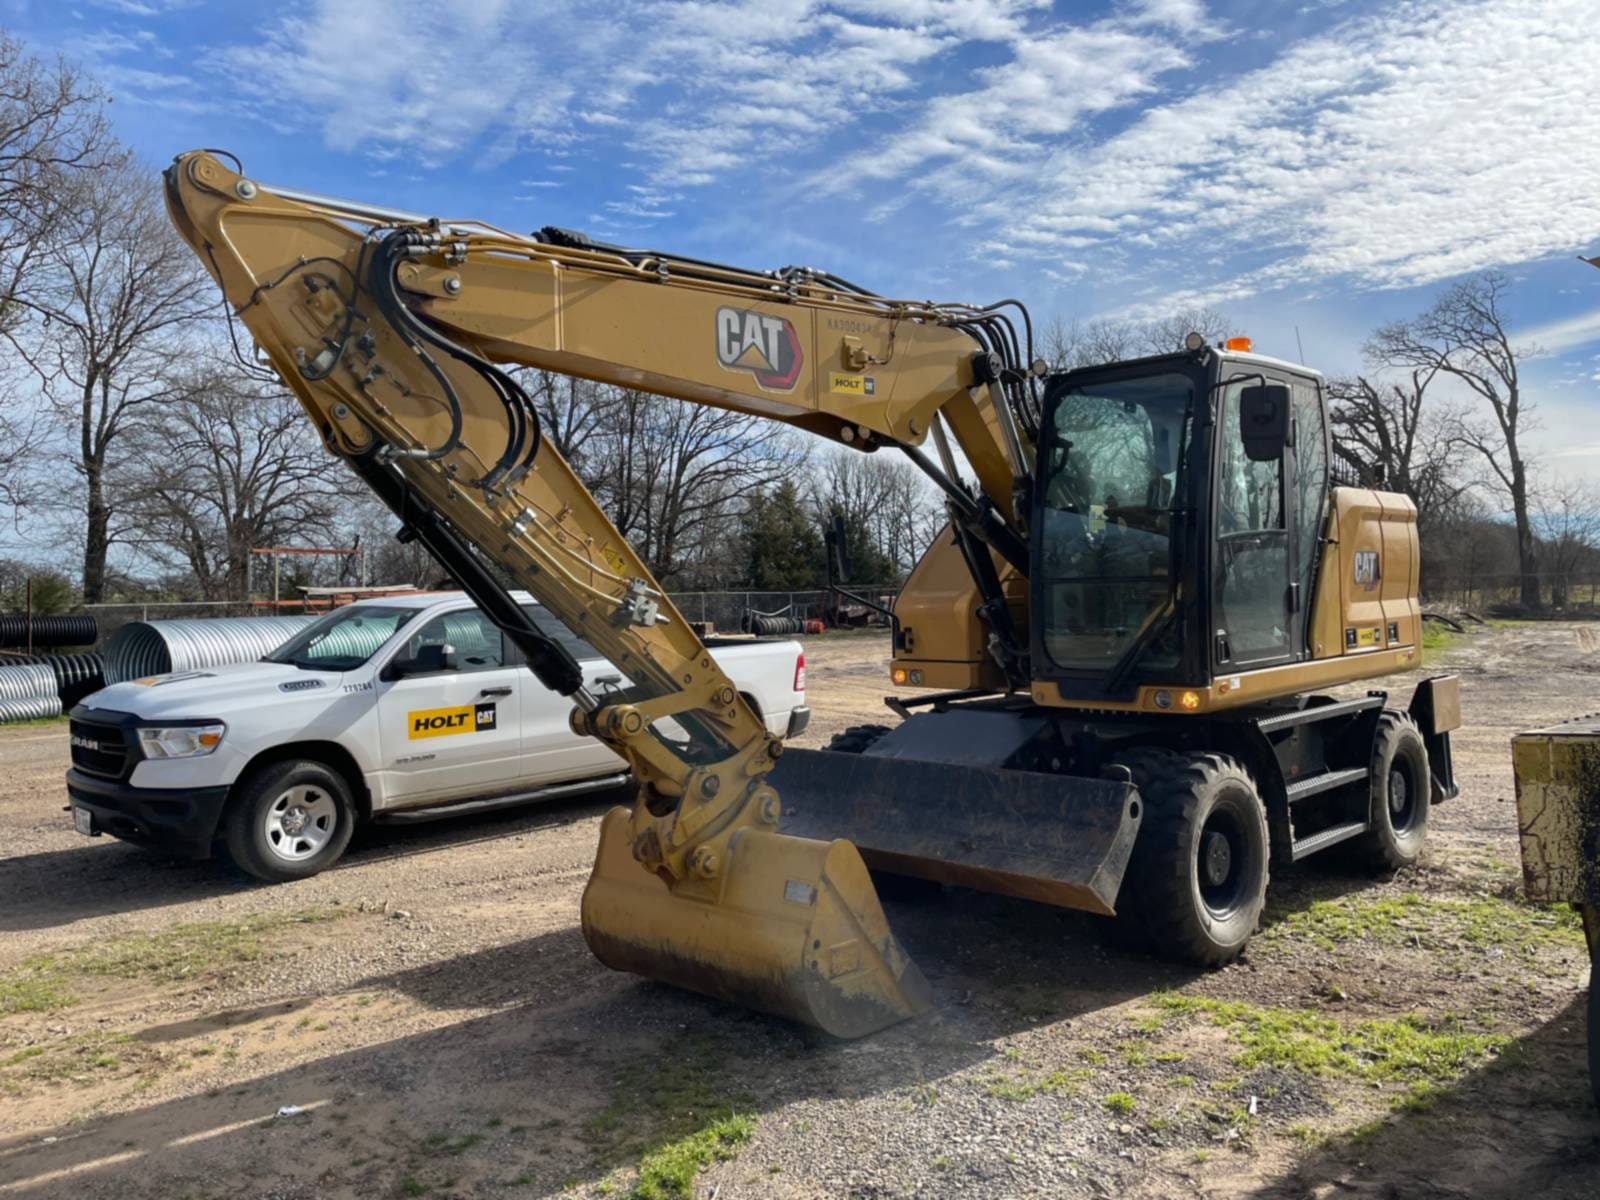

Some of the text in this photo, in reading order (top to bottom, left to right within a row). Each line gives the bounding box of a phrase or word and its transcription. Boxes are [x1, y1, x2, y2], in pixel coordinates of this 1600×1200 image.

[718, 309, 782, 372] CAT
[835, 379, 860, 388] HOLT
[1355, 552, 1376, 583] CAT
[414, 709, 495, 731] HOLT CAT
